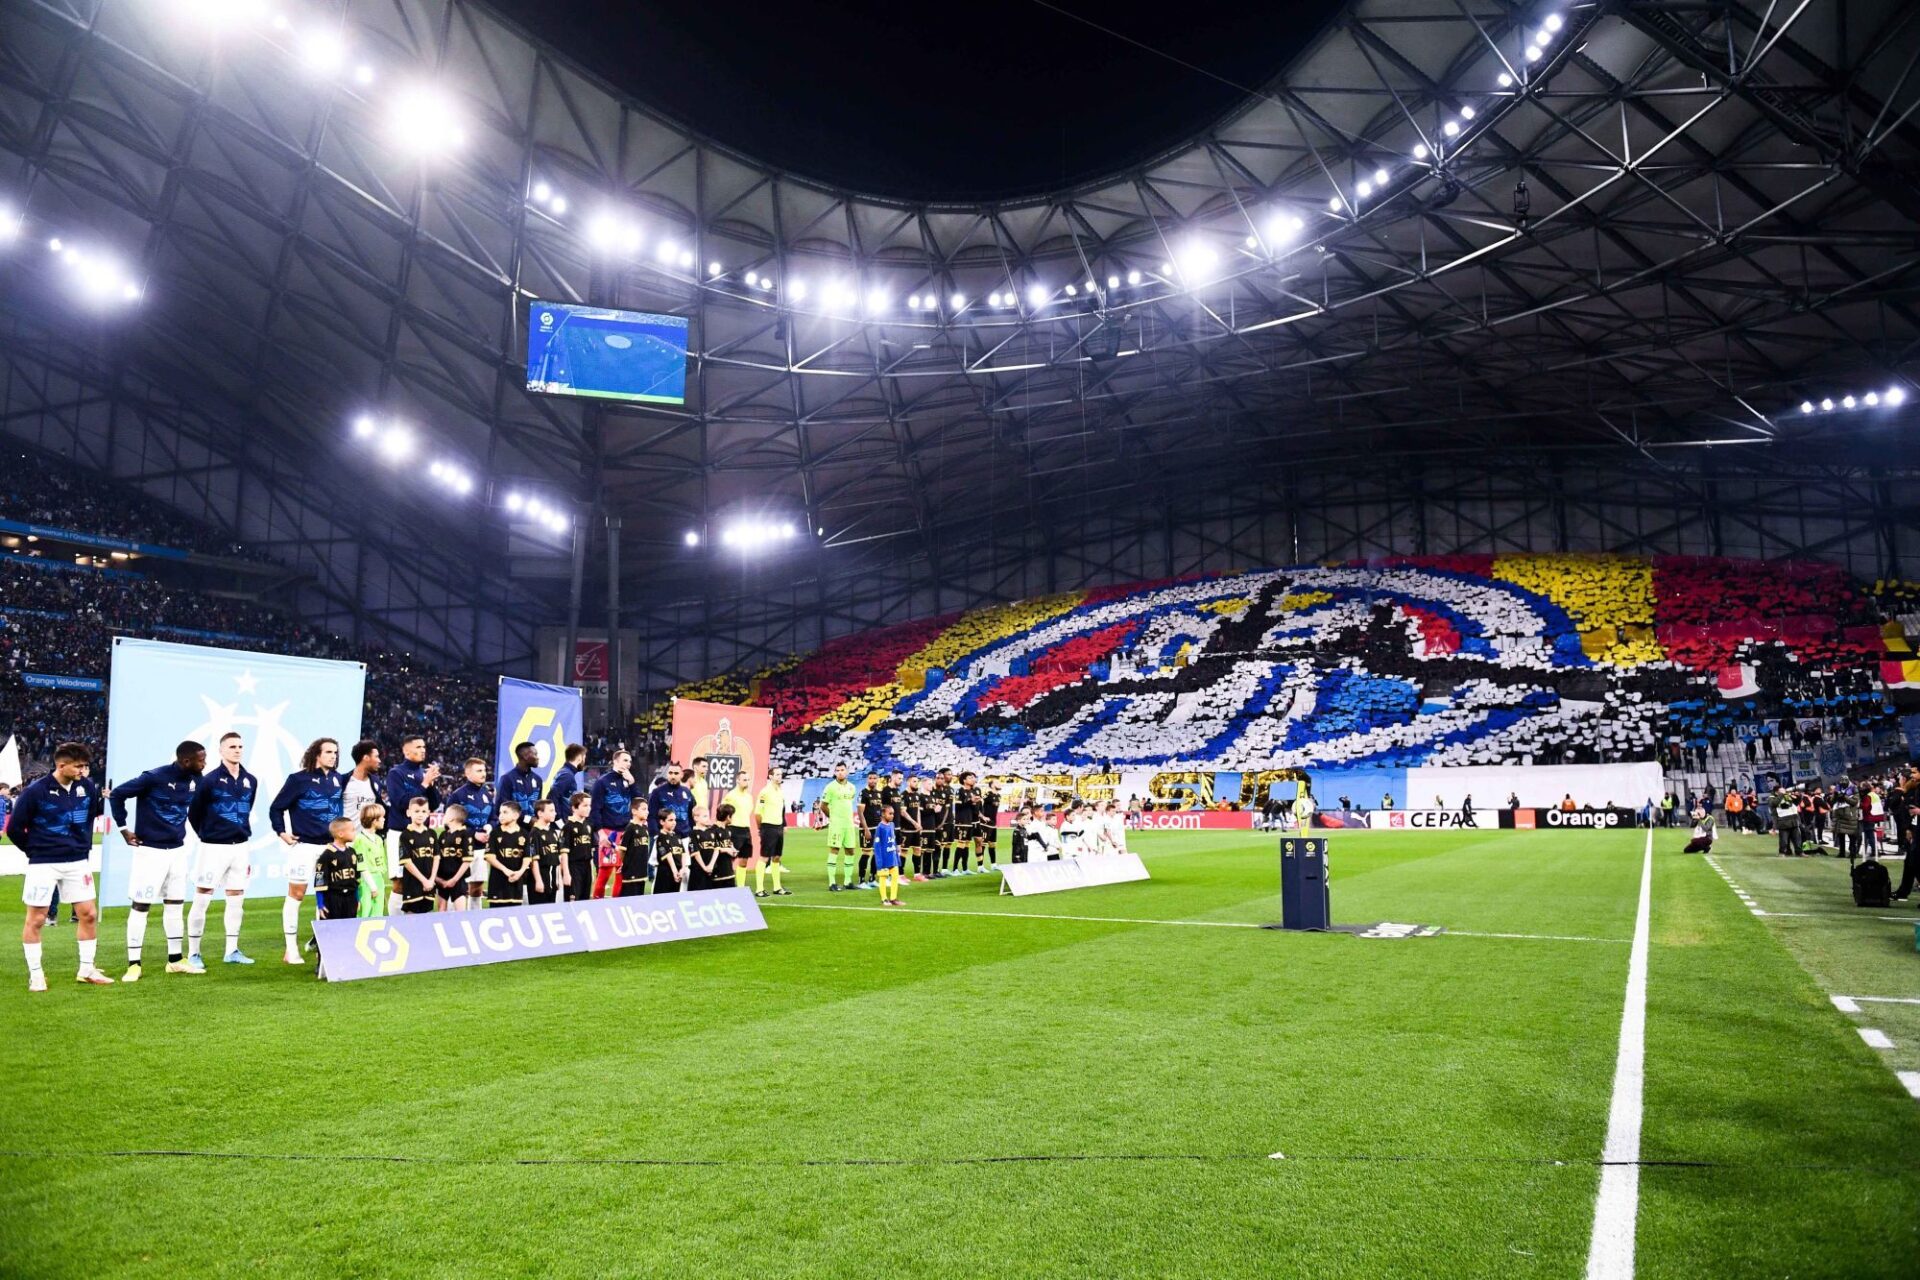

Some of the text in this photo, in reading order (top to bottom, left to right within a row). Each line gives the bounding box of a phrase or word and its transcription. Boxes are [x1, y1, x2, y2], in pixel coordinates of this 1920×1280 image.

[25, 675, 98, 689] Orange Vélodrome
[710, 758, 735, 774] OGC
[709, 773, 734, 788] NICE
[1546, 809, 1619, 829] Orange
[205, 871, 214, 884] 9
[297, 864, 306, 876] 5
[33, 886, 50, 901] 17
[145, 886, 154, 899] 8
[432, 901, 746, 958] LIGUE 1 Uber Eats
